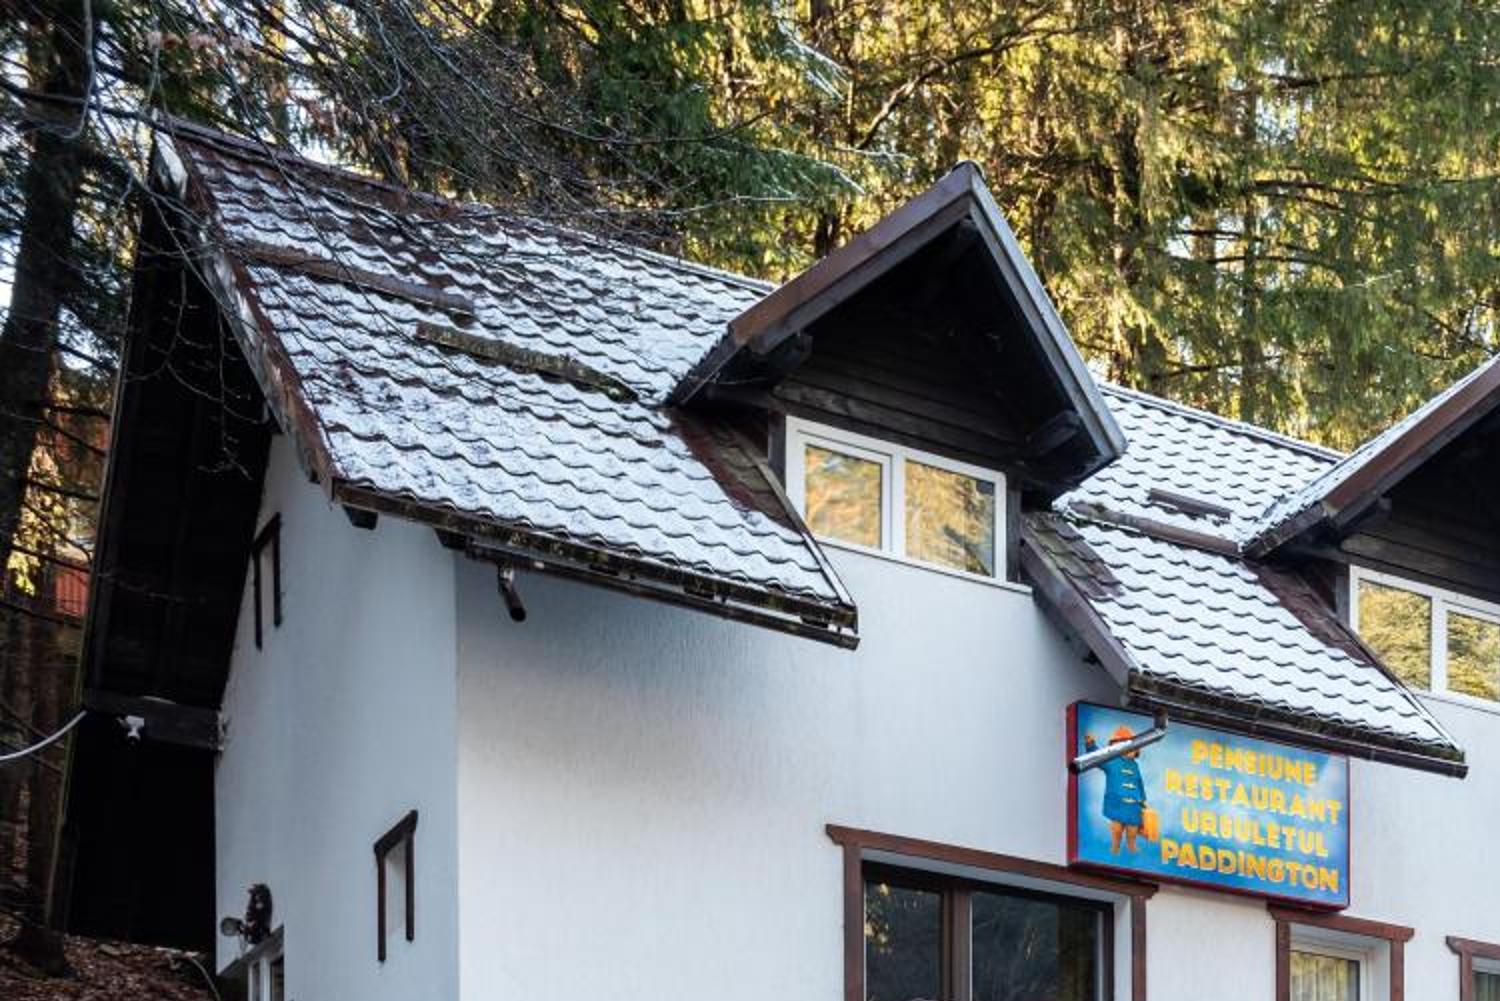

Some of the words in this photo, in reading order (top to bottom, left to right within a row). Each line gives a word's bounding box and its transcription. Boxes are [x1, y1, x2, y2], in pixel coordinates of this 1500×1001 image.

[1190, 739, 1318, 786] PENSIUNE
[1165, 768, 1343, 824] RESTAURANT
[1181, 807, 1329, 858] URSULETUL
[1160, 838, 1340, 893] PADDINGTON
